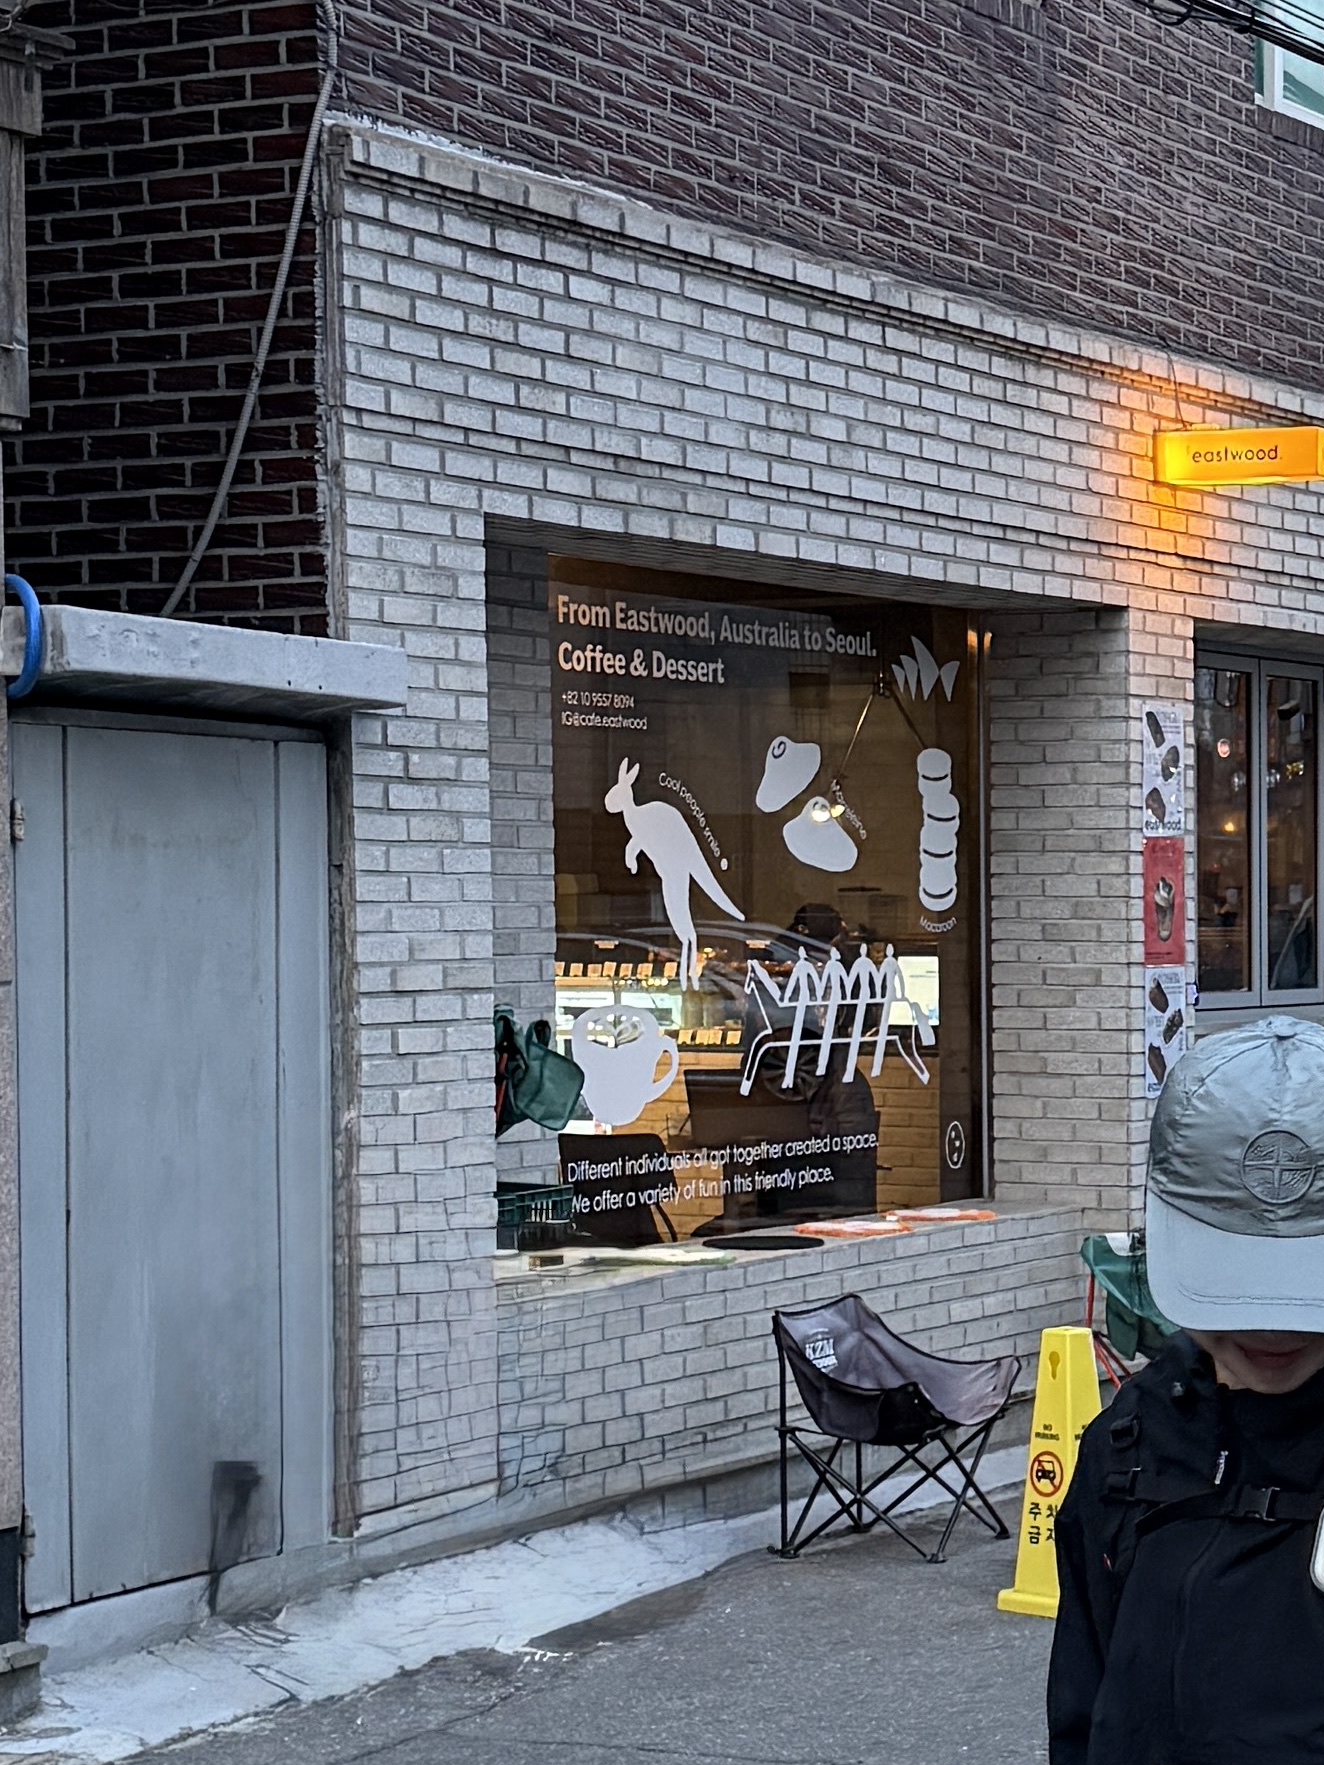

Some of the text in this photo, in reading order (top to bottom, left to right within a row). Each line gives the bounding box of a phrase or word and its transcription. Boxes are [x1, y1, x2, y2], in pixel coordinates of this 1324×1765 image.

[557, 594, 877, 657] From Eastwood, Australia to Seoul.
[558, 641, 725, 684] Coffee & Dessert
[562, 691, 578, 704] +82
[580, 691, 590, 706] 10
[659, 772, 682, 792] Cool
[568, 1157, 622, 1183] Different
[625, 1150, 690, 1176] individuals
[711, 1144, 729, 1170] got
[733, 1141, 784, 1166] together
[785, 1134, 830, 1157] created
[832, 1137, 841, 1151] a
[842, 1132, 879, 1154] space.
[593, 1189, 623, 1212] offer
[626, 1192, 636, 1207] a
[638, 1181, 681, 1206] variety
[684, 1180, 696, 1200] of
[699, 1177, 718, 1198] fun
[720, 1175, 730, 1197] in
[734, 1173, 752, 1194] this
[755, 1168, 797, 1193] friendly
[799, 1166, 834, 1189] place.
